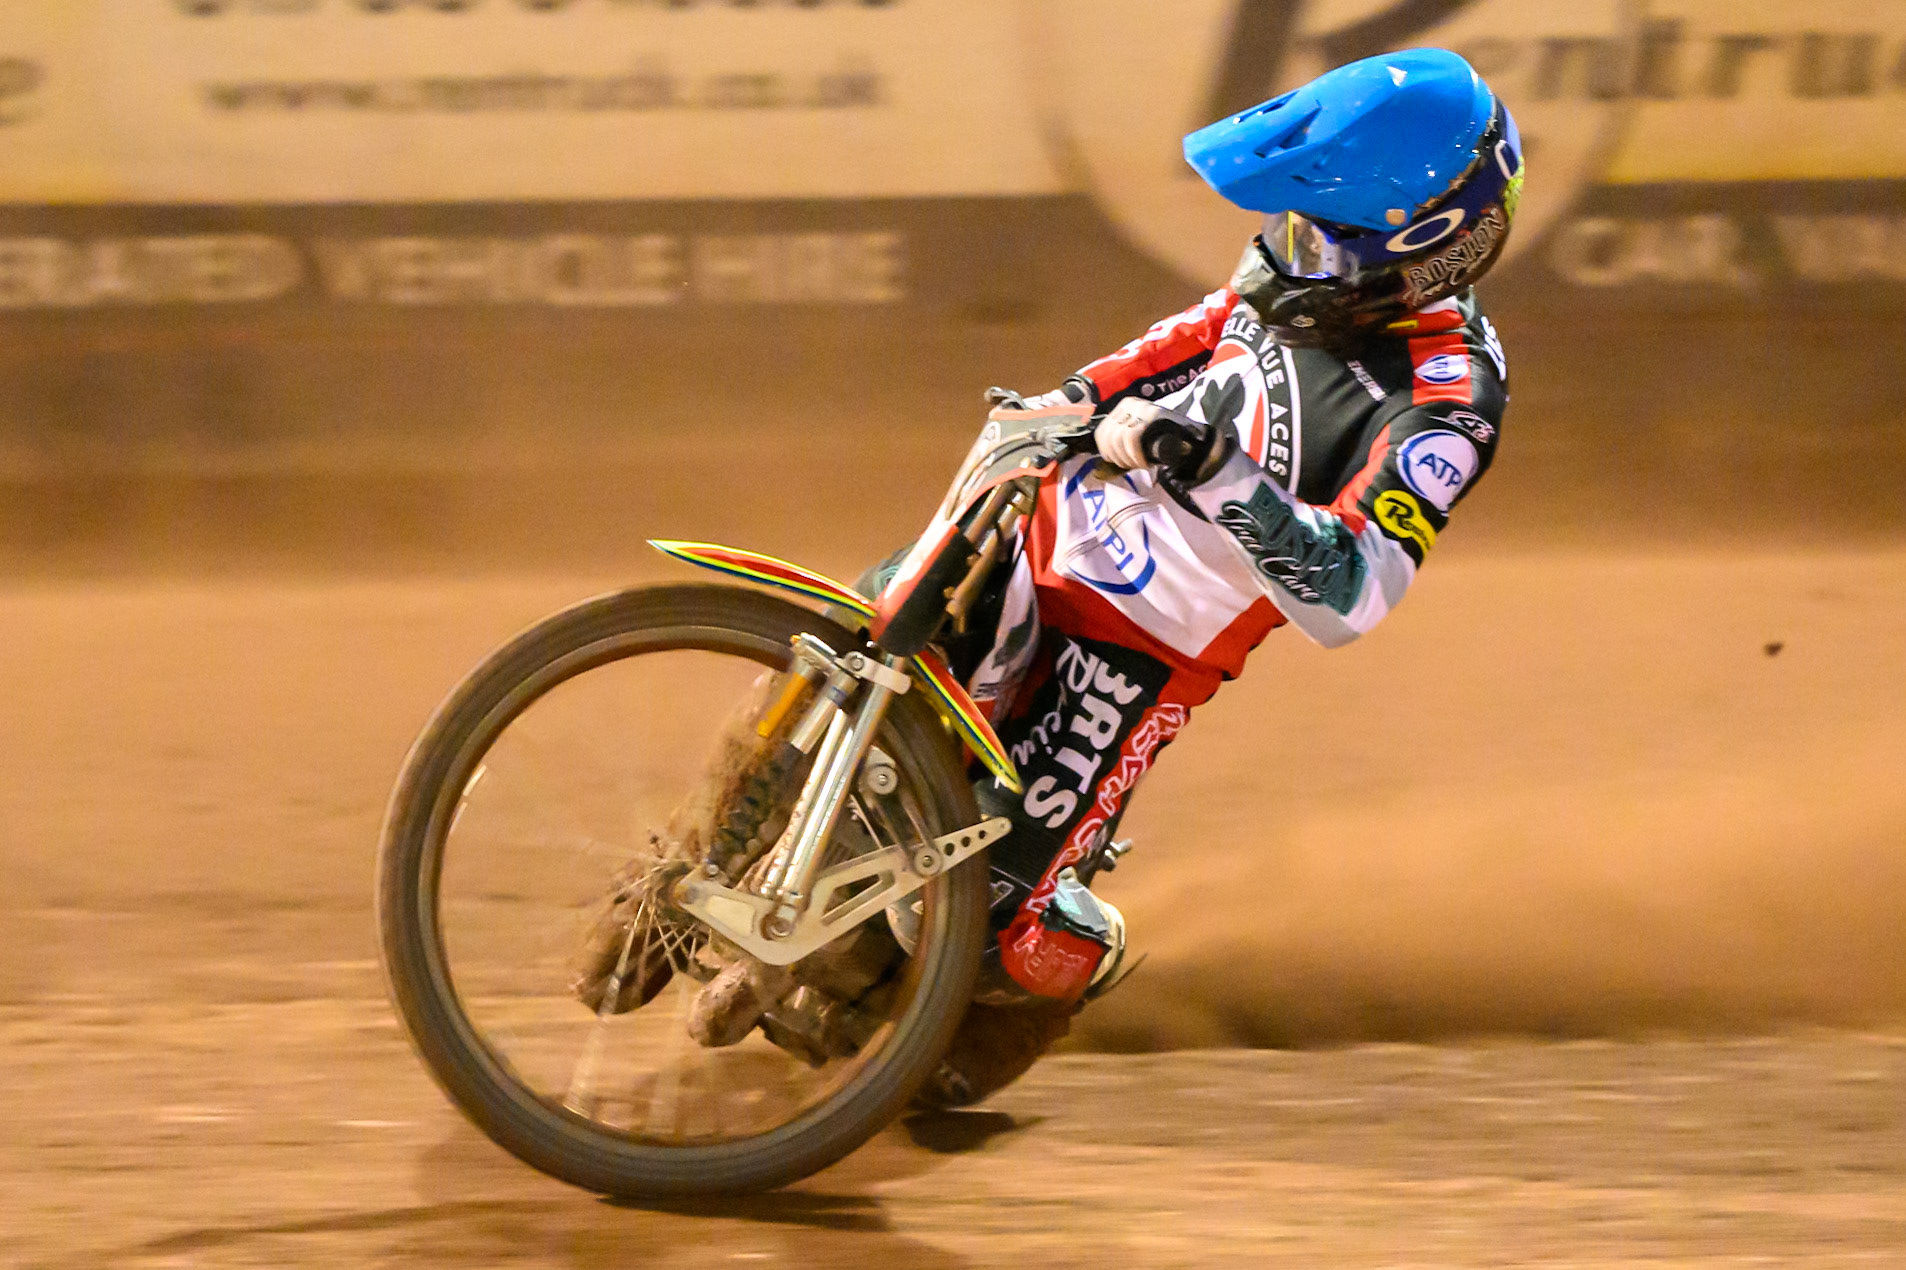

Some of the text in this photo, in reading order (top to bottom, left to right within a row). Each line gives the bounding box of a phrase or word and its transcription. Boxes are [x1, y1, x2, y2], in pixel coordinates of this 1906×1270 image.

[1258, 336, 1285, 389] VUE
[1269, 402, 1289, 477] ACES
[996, 637, 1100, 790] Rcin
[1023, 658, 1144, 829] BRTS
